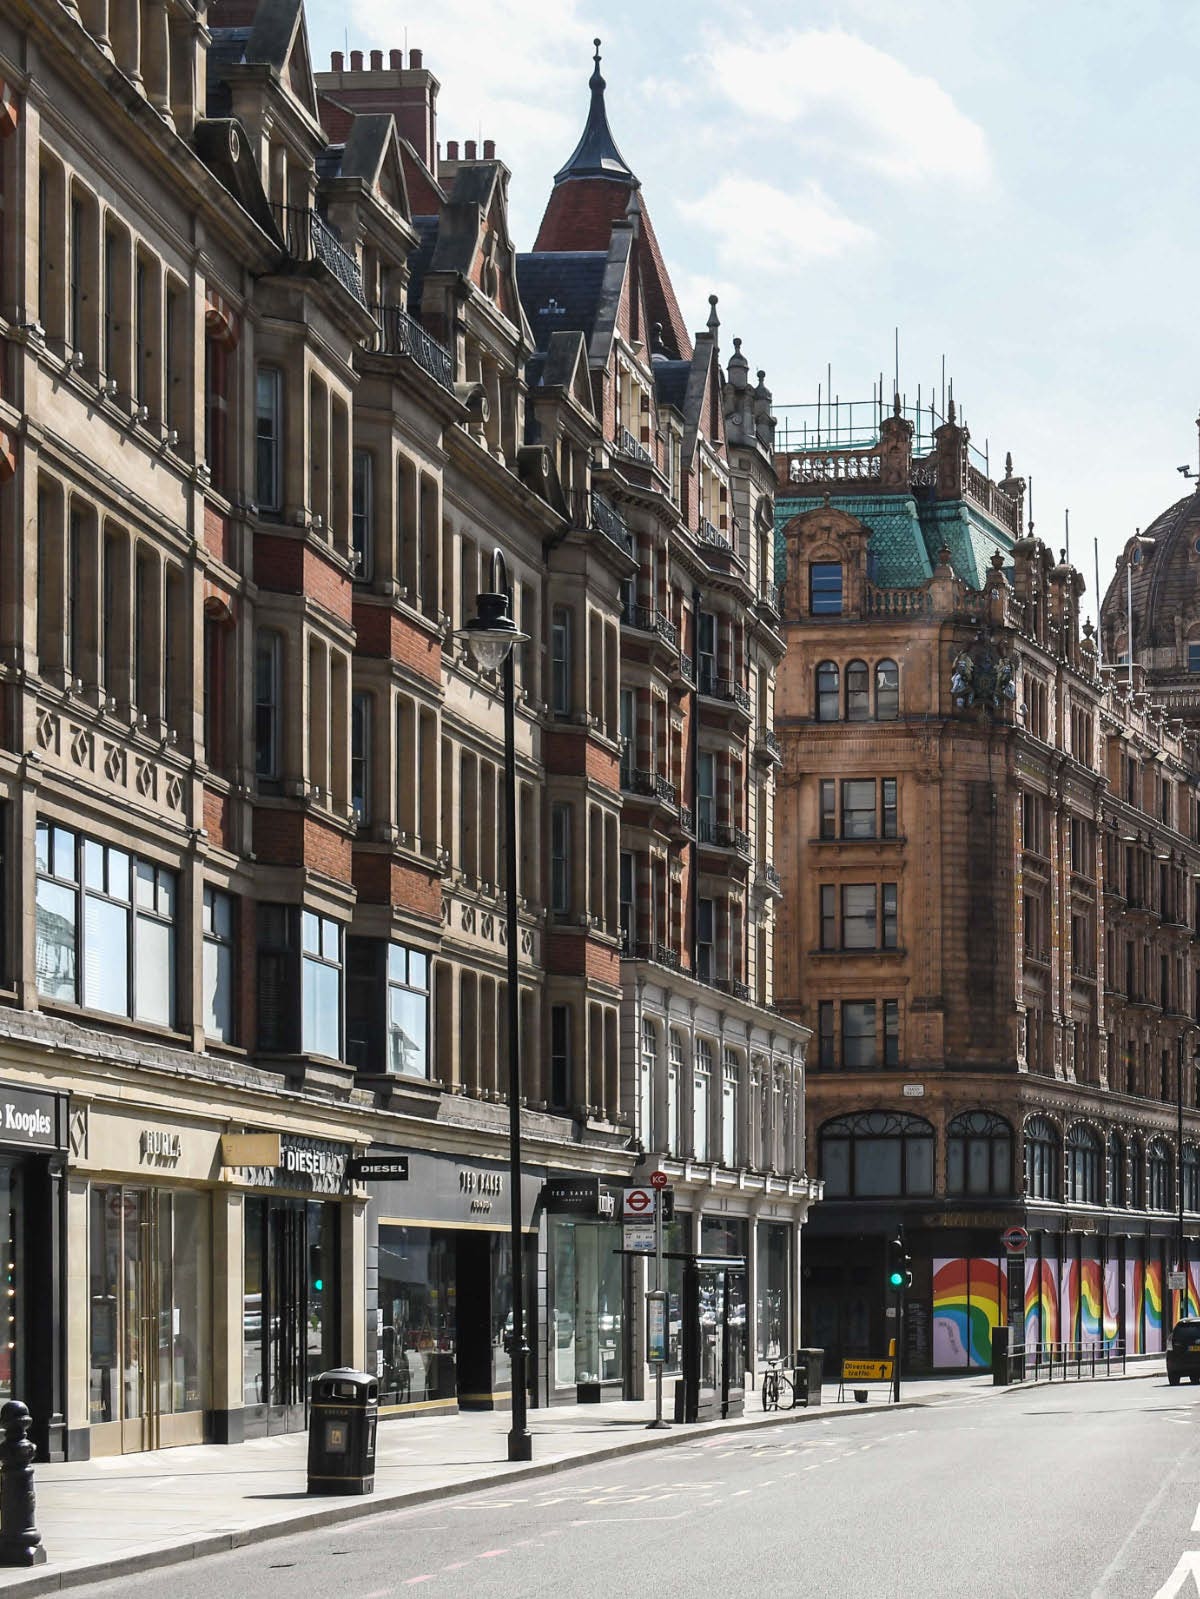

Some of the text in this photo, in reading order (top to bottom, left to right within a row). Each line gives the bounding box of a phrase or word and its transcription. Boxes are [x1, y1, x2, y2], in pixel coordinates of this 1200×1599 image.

[5, 1103, 51, 1138] Kooples
[286, 1151, 326, 1175] DIESEL
[360, 1164, 406, 1174] DIESEL
[461, 1170, 477, 1190] TED
[652, 1175, 665, 1184] KC
